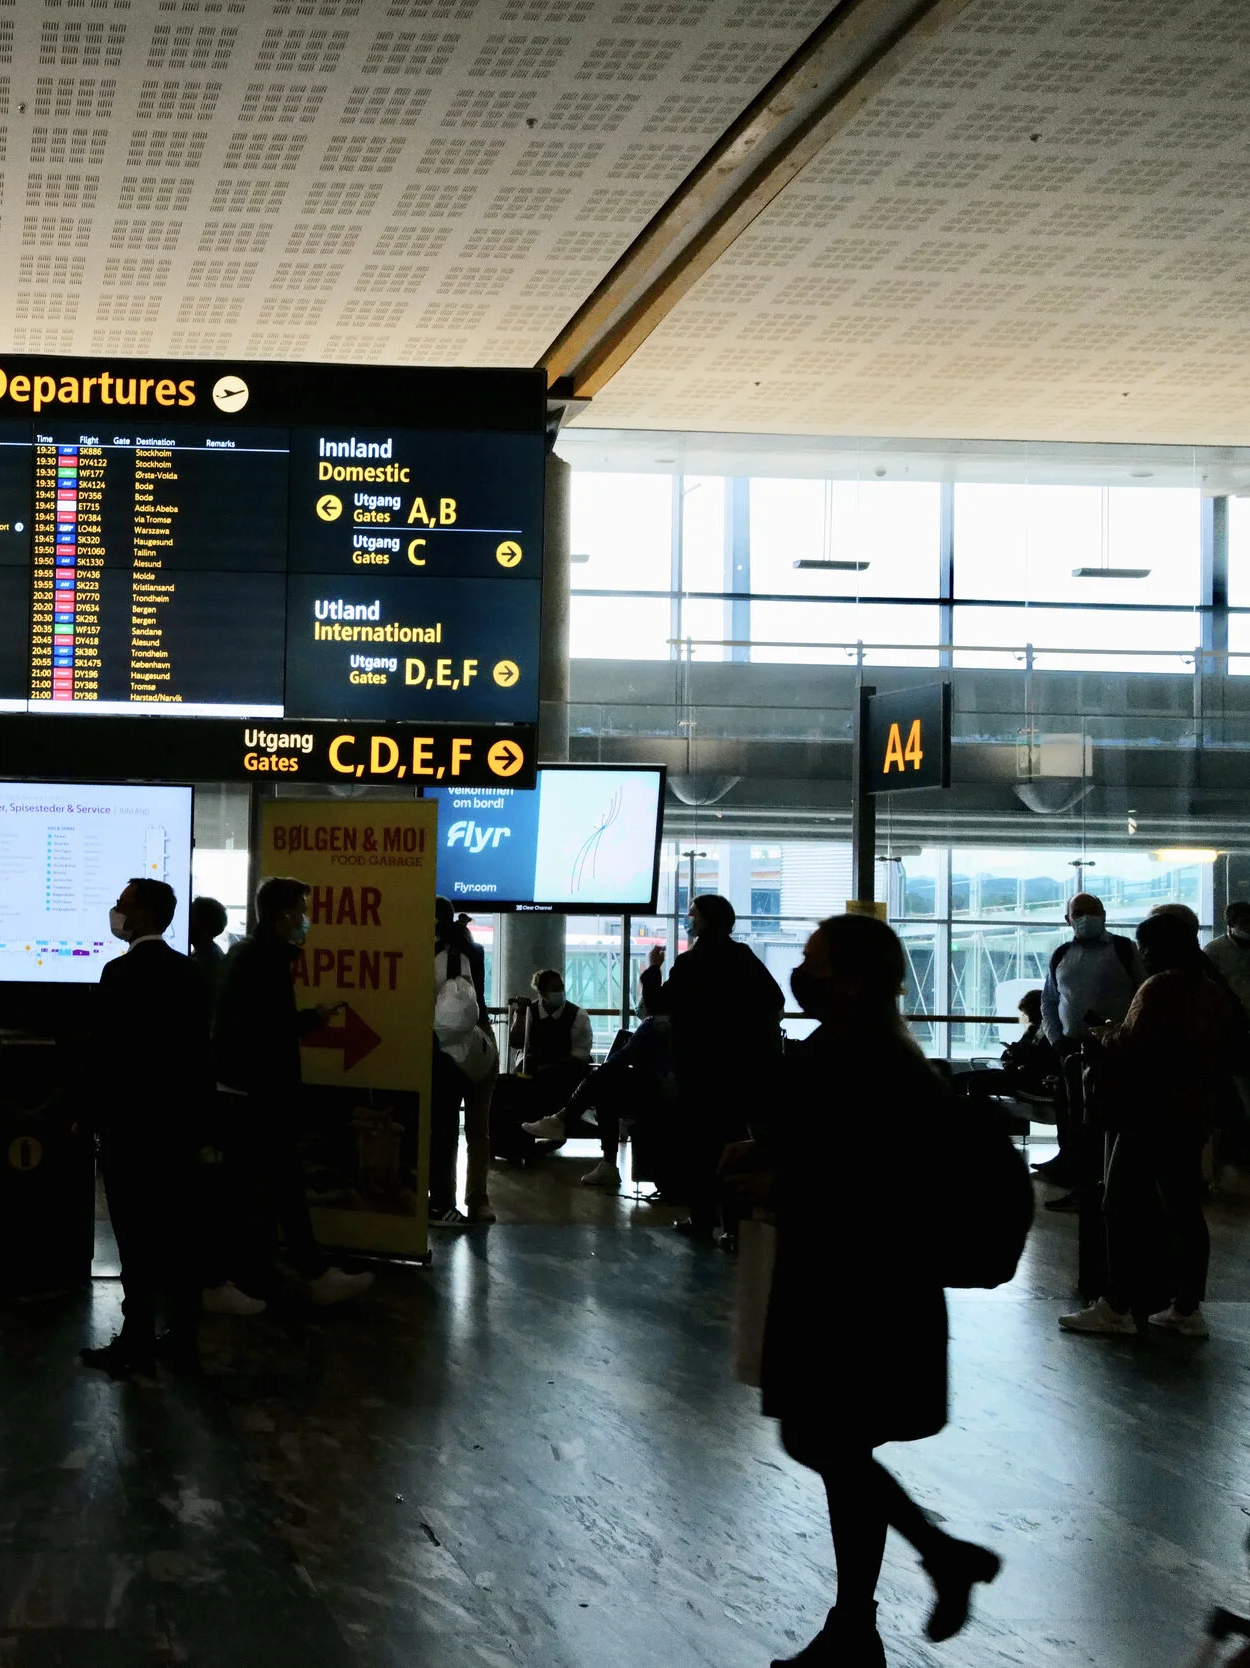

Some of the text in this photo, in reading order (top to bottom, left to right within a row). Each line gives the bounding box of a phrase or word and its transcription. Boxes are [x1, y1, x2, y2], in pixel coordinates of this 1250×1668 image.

[36, 435, 236, 448] Time Flight Gate Destination Remarks
[320, 438, 392, 458] Innland
[36, 446, 57, 455] 19:25
[135, 448, 172, 458] Stockholm
[36, 468, 57, 477] 19:30
[134, 470, 178, 480] Ørsta-Volda
[319, 462, 409, 482] Domestic
[35, 501, 56, 510] 19:45
[134, 504, 155, 513] Addis
[155, 504, 179, 513] Abeba
[354, 493, 456, 528] Utgang A,B
[353, 510, 391, 523] Gates
[35, 523, 55, 532] 19:45
[134, 526, 170, 535] Warszawa
[353, 535, 425, 565] Utgang C
[352, 551, 389, 565] Gates
[33, 580, 54, 589] 19:55
[132, 583, 175, 592] Kristiansand
[315, 599, 380, 620] Utland
[32, 624, 53, 634] 20:35
[131, 627, 163, 636] Sandane
[315, 622, 441, 642] International
[31, 646, 53, 656] 20:45
[130, 649, 169, 659] Trondheim
[31, 668, 52, 678] 21:00
[130, 671, 171, 682] Haugesund
[350, 655, 477, 689] Utgang D,E,F
[350, 671, 387, 685] Gates
[884, 720, 923, 773] A4
[245, 729, 472, 779] Utgang C,D,E,F
[244, 753, 298, 771] Gates
[10, 802, 65, 814] Spisesteder
[67, 804, 76, 814] &
[76, 804, 111, 815] Service
[453, 798, 505, 809] om bord!
[273, 824, 425, 854] BØLGEN & MOI
[447, 820, 512, 855] Flyr
[330, 855, 423, 867] FOOD GARAGE
[454, 881, 497, 894] Flyr.com
[311, 885, 382, 926] HAR
